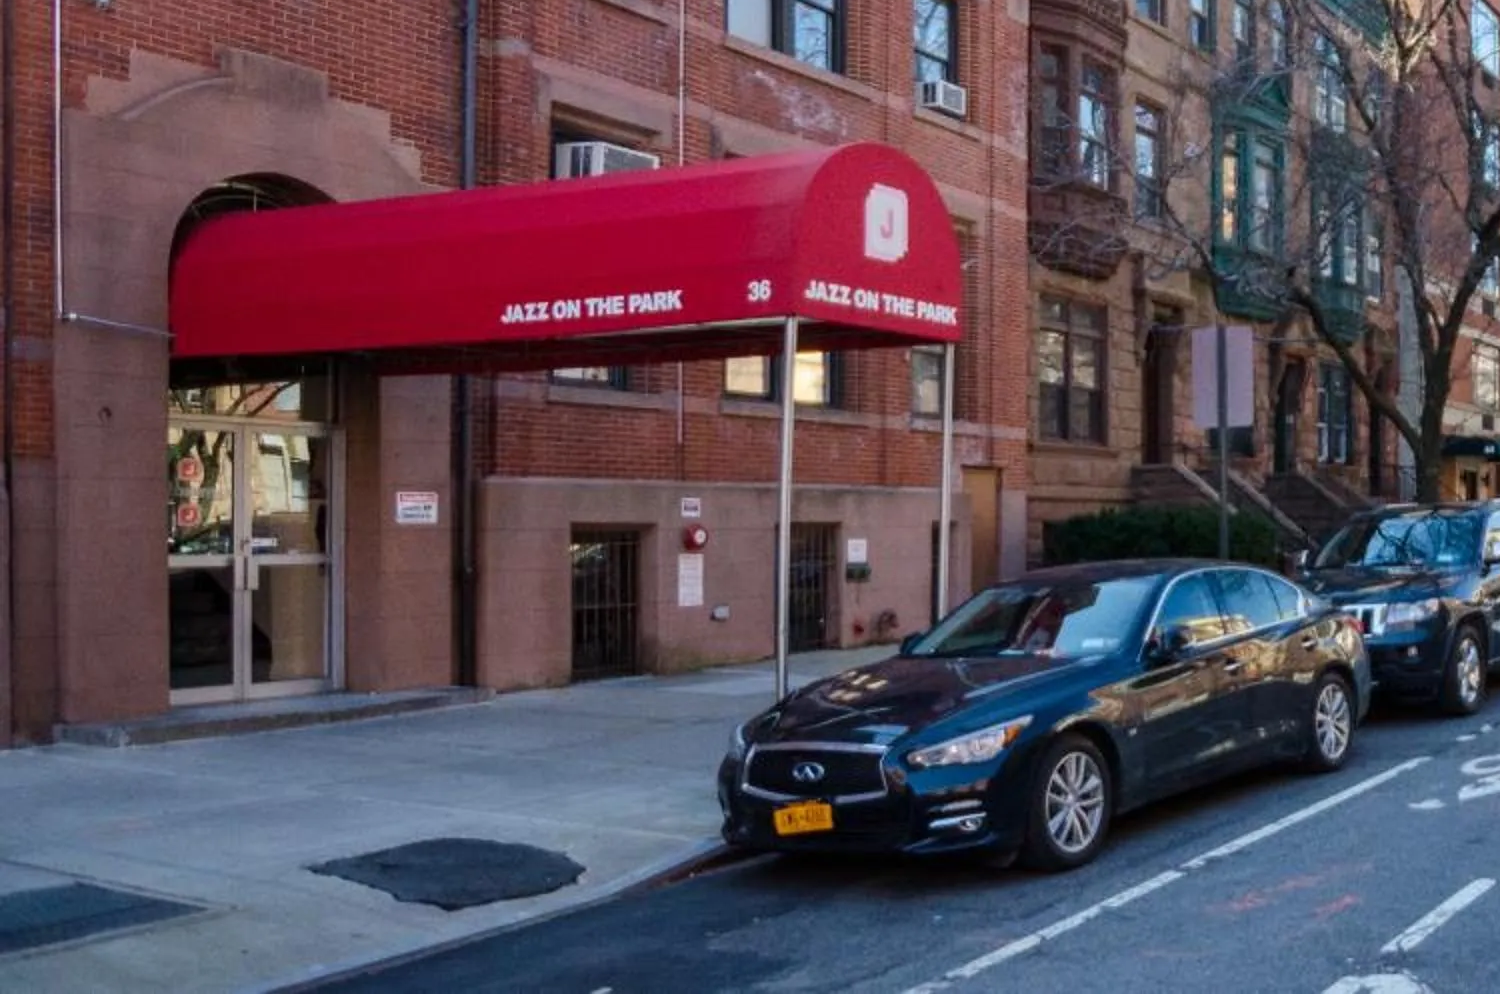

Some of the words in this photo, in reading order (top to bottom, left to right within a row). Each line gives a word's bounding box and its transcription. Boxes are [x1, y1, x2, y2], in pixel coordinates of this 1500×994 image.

[501, 302, 549, 324] JAZZ
[552, 299, 581, 320] ON
[585, 295, 625, 317] THE
[628, 290, 683, 313] PARK
[747, 279, 771, 301] 36
[804, 280, 851, 306] JAZZ
[853, 289, 879, 311] ON
[882, 294, 915, 317] THE
[917, 301, 958, 326] PARK
